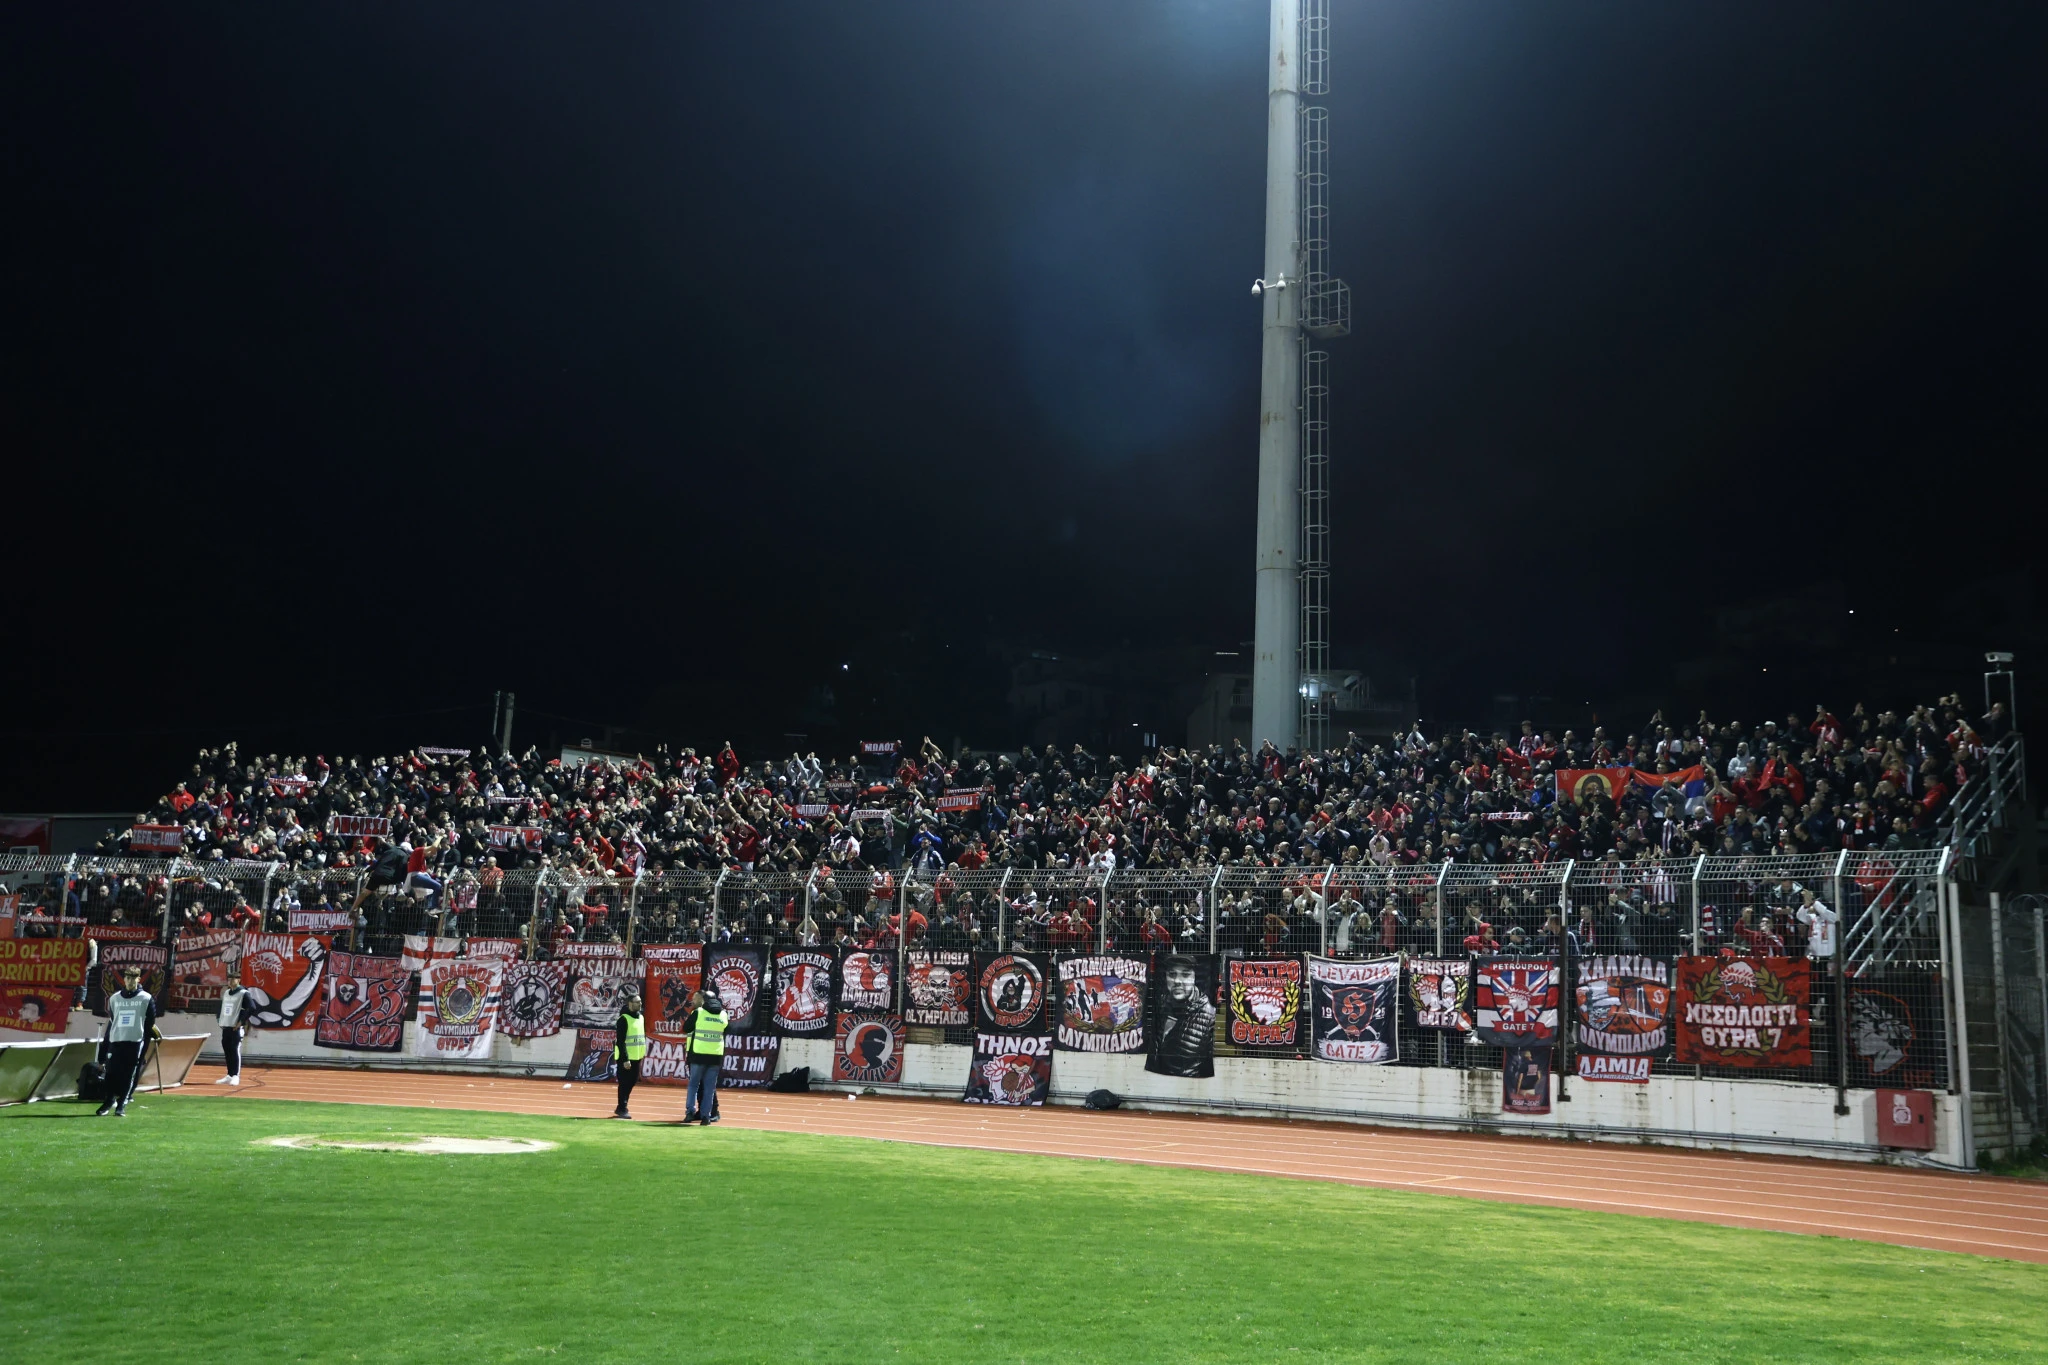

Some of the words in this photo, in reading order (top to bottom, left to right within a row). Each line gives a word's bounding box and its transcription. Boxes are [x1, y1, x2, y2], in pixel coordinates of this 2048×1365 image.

[20, 943, 39, 959] or
[42, 941, 84, 959] DEAD
[180, 930, 237, 952] ΠΕΡΑΜΑ
[242, 933, 294, 962] KAMINIA
[103, 947, 167, 963] SANTORINI
[777, 952, 833, 971] ΜΠΡΑΧΑΜΙ
[908, 952, 931, 964] NEA
[934, 952, 969, 965] LIOSIA
[431, 964, 496, 985] ΚΟΛΩΝΟΣ
[508, 964, 561, 989] SEPOLIA
[570, 959, 647, 978] PASALIMANI
[980, 955, 1014, 987] ΒΟΡΕΙΑ
[1058, 956, 1147, 984] ΜΕΤΑΜΟΡΦΩΣΗ
[1230, 961, 1300, 983] ΚΑΣΤΡΟ
[1317, 965, 1391, 981] LEVADIA
[1409, 959, 1470, 976] PERISTERI
[1578, 956, 1667, 985] ΧΑΛΚΙΔΑ
[38, 989, 62, 1001] BOYS
[842, 983, 891, 1009] KAMATERO
[905, 1009, 969, 1024] OLYMPIAKOS
[1321, 1006, 1333, 1018] 19
[1374, 1006, 1386, 1018] 25
[1418, 1010, 1450, 1026] GATE
[1686, 1003, 1798, 1026] ΜΕΣΟΛΟΓΓΙ
[434, 1024, 480, 1035] ΟΛΥΜΠΙΑΚΟΣ
[654, 1019, 682, 1034] gate
[773, 1013, 829, 1031] ΟΛΥΜΠΙΑΚΟΣ
[1502, 1022, 1526, 1031] GATE
[1529, 1022, 1536, 1031] 7
[357, 1024, 401, 1046] STOP
[746, 1035, 778, 1050] ΓΕΡΑ
[978, 1033, 1053, 1056] ΤΗΝΟΣ
[1058, 1024, 1144, 1052] ΟΛΥΜΠΙΑΚΟΣ
[1580, 1024, 1667, 1053] ΟΛΥΜΠΙΑΚΟΣ
[1701, 1027, 1761, 1048] ΘΥΡΑ
[1768, 1028, 1782, 1048] 7
[645, 1039, 687, 1061] ΓΑΛΑ
[1325, 1043, 1365, 1059] GATE
[1370, 1044, 1380, 1059] 7
[742, 1055, 768, 1072] ΤΗΝ
[840, 1056, 899, 1081] ΦΑΛΗΡΟ
[1579, 1056, 1649, 1078] ΛΑΜΙΑ
